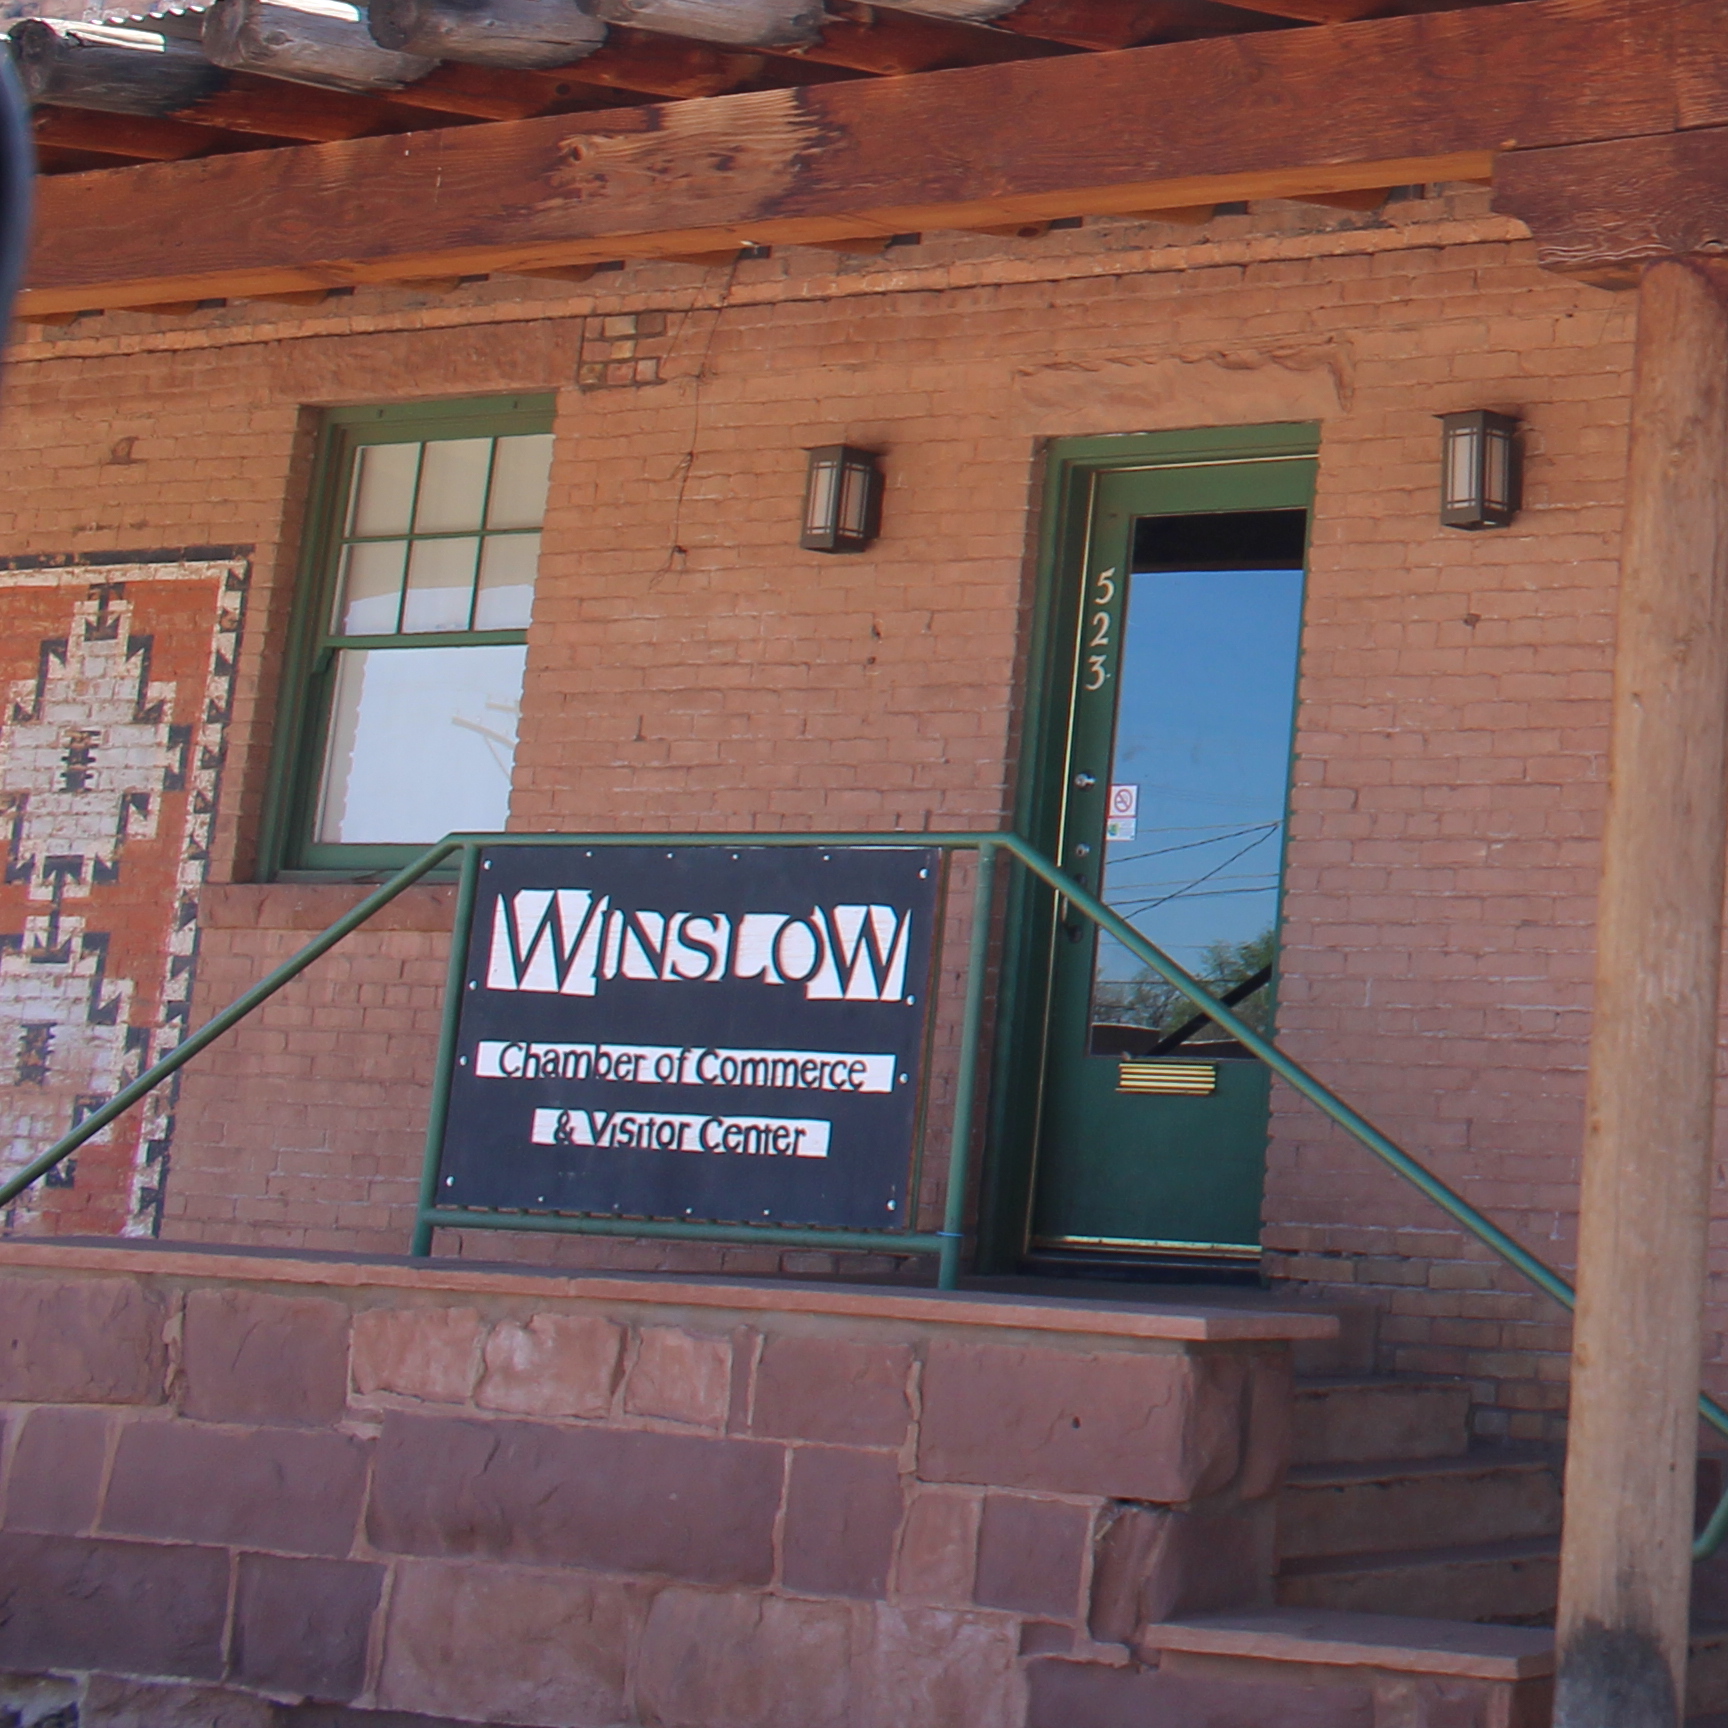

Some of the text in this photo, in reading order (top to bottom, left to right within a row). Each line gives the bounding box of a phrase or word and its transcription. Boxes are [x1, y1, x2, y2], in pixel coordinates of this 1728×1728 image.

[1084, 567, 1116, 691] 523
[486, 888, 911, 1002] WINSLOW
[499, 1041, 868, 1090] Chamber of Commerce
[553, 1110, 807, 1156] & Visitor Center
